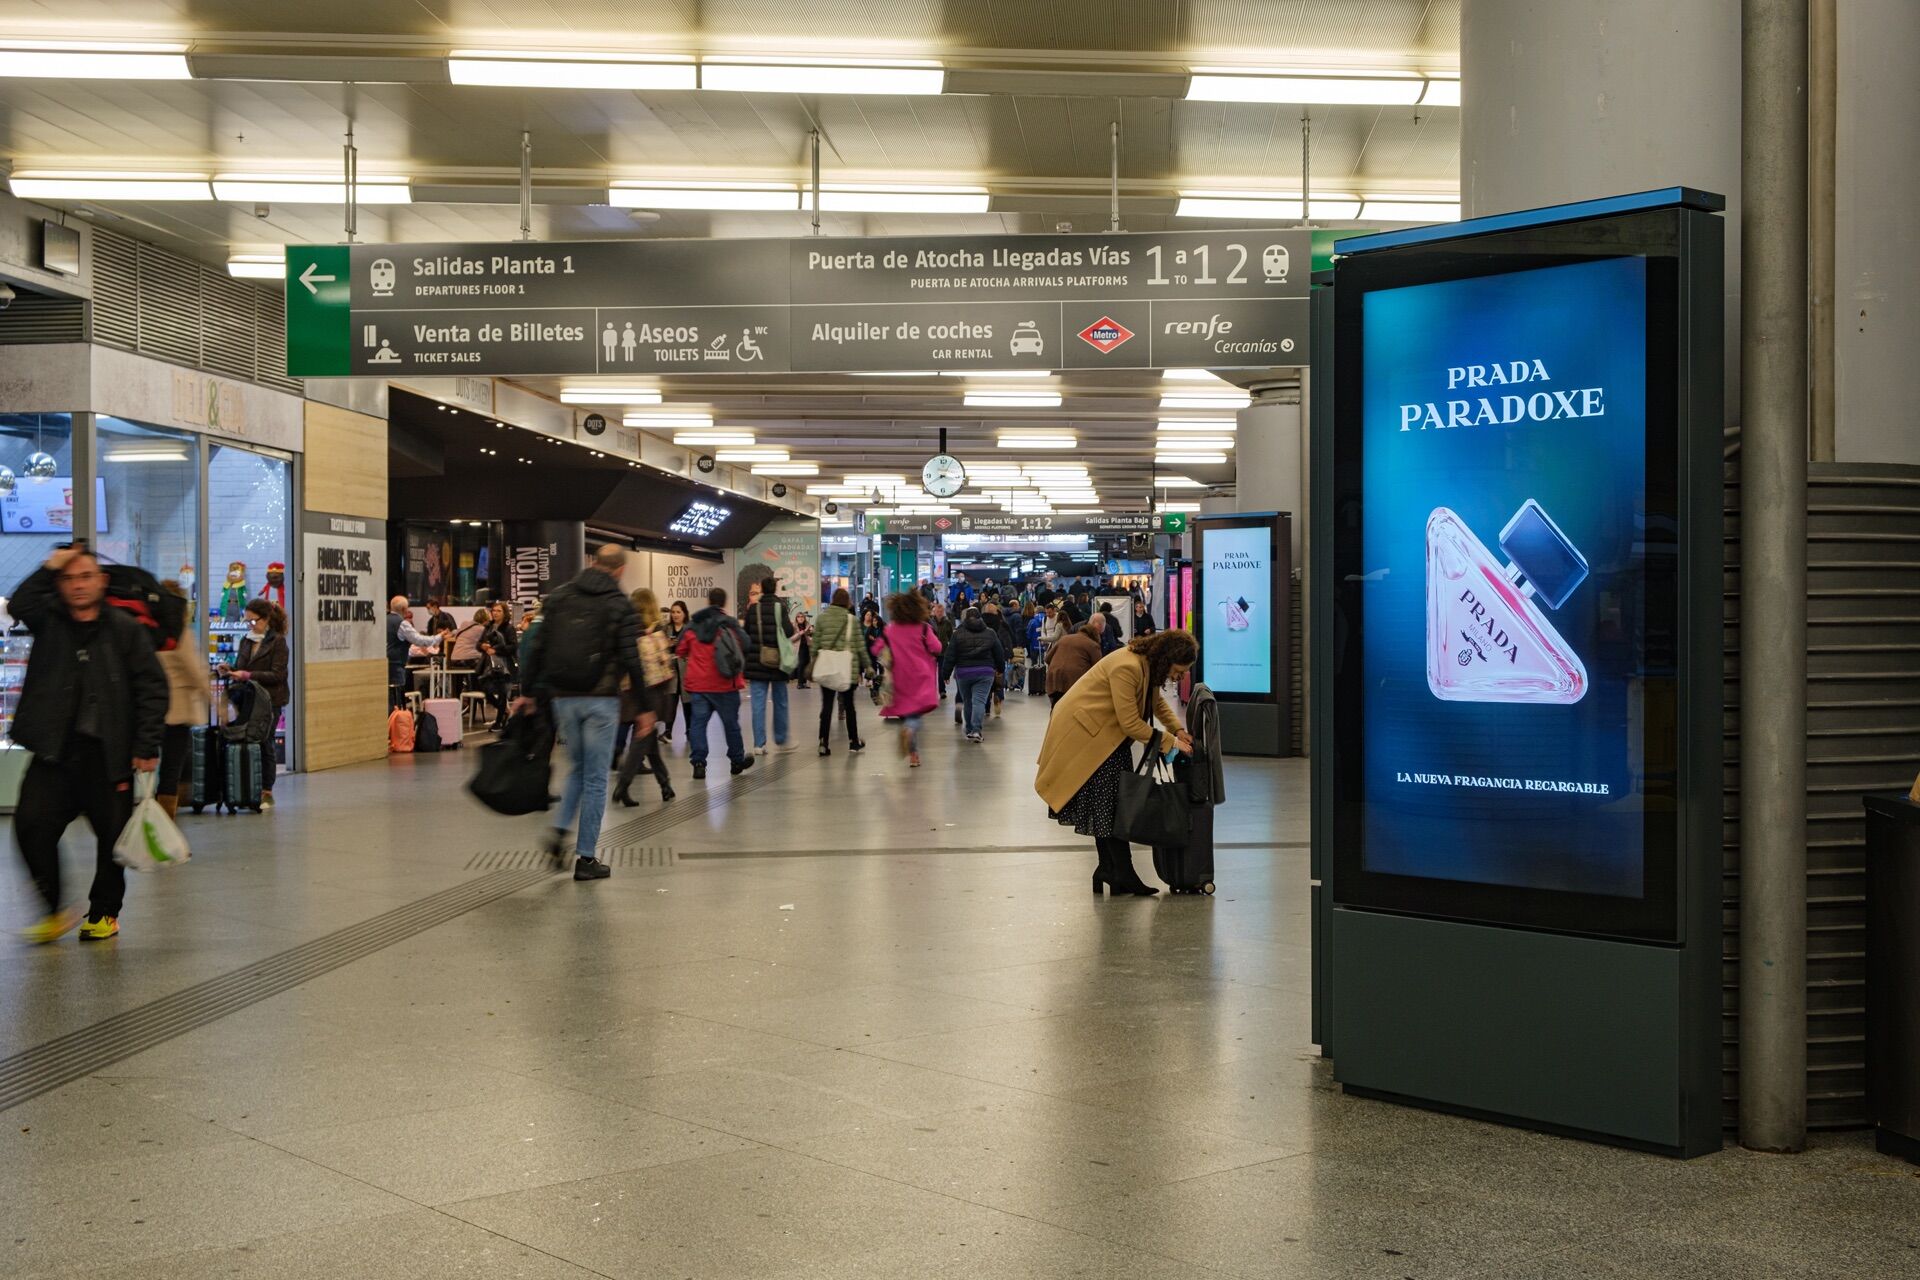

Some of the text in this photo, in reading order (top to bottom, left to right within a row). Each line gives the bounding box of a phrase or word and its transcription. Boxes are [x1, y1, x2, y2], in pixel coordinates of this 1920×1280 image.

[413, 255, 575, 276] Salidas Planta 1
[809, 251, 875, 270] Puerta
[883, 250, 908, 269] de
[915, 249, 984, 268] Atocha
[993, 248, 1083, 271] Llegadas
[1088, 245, 1130, 266] Vías
[1146, 245, 1169, 285] 1
[1175, 250, 1187, 264] a
[910, 275, 1187, 289] PUERTA DE ATOCHA ARRIVALS PLATFORMS TO
[415, 284, 525, 296] DEPARTURES FLOOR 1
[413, 322, 584, 343] Venta de Billetes
[639, 323, 698, 344] Aseos
[754, 326, 768, 335] WC
[812, 321, 993, 345] Alquiler de coches
[1164, 313, 1233, 341] renfe
[1093, 330, 1118, 340] Metro
[1214, 338, 1278, 353] Cercanías
[413, 352, 481, 363] TICKET SALES
[654, 348, 699, 362] TOILETS
[932, 348, 993, 359] CAR RENTAL
[1447, 359, 1551, 390] PRADA
[1400, 387, 1605, 432] PARADOXE
[587, 419, 603, 428] DOTS
[974, 517, 1003, 525] Llegadas
[1111, 516, 1132, 524] Planta
[538, 547, 550, 581] QUALITY
[667, 565, 689, 576] DOTS
[1212, 561, 1261, 570] PARADOXE
[516, 546, 539, 608] DITION
[667, 576, 714, 587] IS ALWAYS
[773, 566, 815, 598] 29
[667, 588, 674, 599] A
[676, 587, 699, 599] GOOD
[1458, 588, 1518, 664] PRADA
[1397, 772, 1609, 795] LA NUEVA FRAGANCIA RECARGABLE
